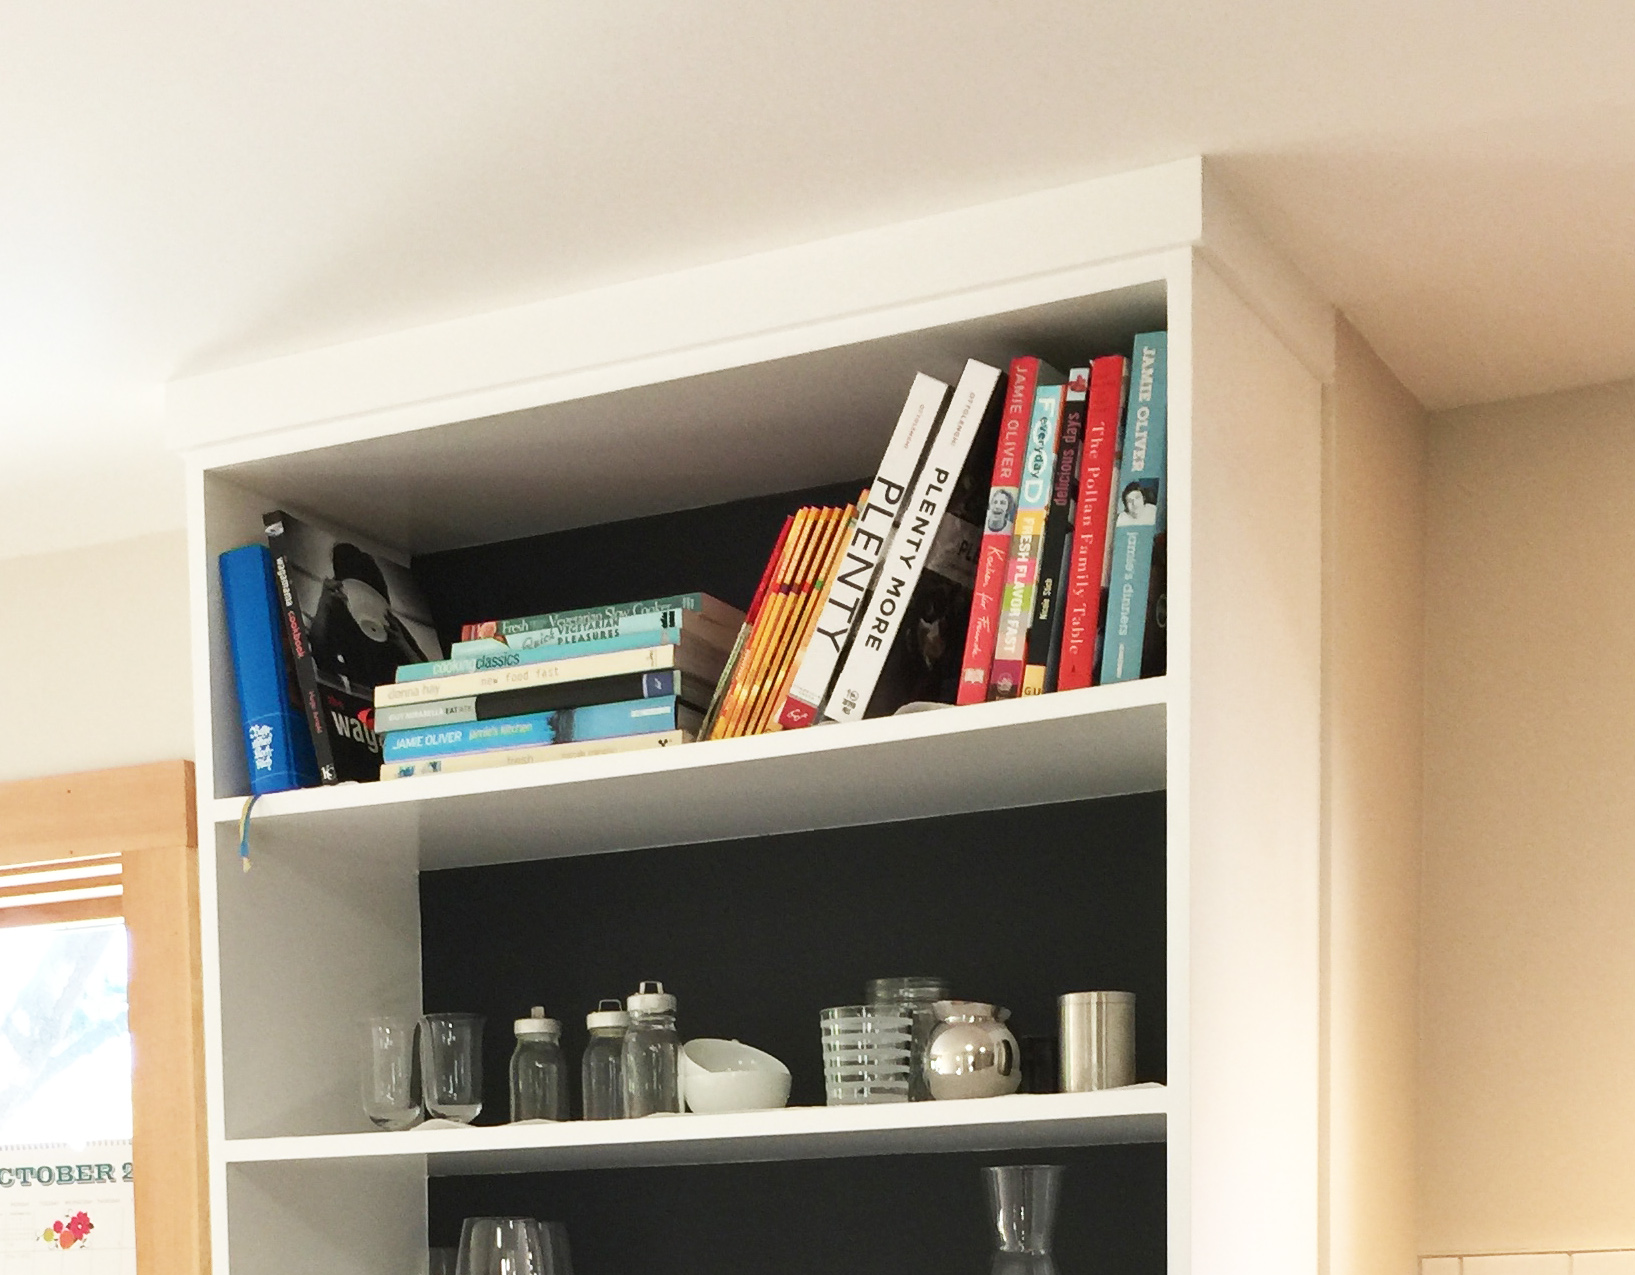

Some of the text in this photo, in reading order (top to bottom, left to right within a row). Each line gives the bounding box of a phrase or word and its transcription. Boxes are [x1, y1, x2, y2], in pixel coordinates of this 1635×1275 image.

[1000, 366, 1028, 478] JAMIE OLIVER
[1131, 346, 1156, 472] JAMIE OLIVER
[1054, 411, 1082, 507] delicious days
[817, 476, 905, 654] PLENTY
[865, 467, 950, 652] PLENTY MORE
[1069, 421, 1106, 655] The Pollan Family Table
[1003, 517, 1035, 653] FRESH FLAVOR FAST
[1118, 583, 1136, 637] dinners
[287, 610, 305, 658] cookbook
[502, 619, 529, 635] Fresh
[549, 612, 603, 628] Vegetarian
[605, 606, 632, 621] Slow
[632, 602, 672, 616] Cooker
[557, 617, 620, 636] VEGETARIAN
[557, 629, 620, 645] PLEASURES
[475, 652, 520, 670] classics
[506, 671, 529, 682] food
[536, 666, 560, 679] fast
[392, 735, 425, 750] JAMIE
[425, 730, 463, 747] OLIVER
